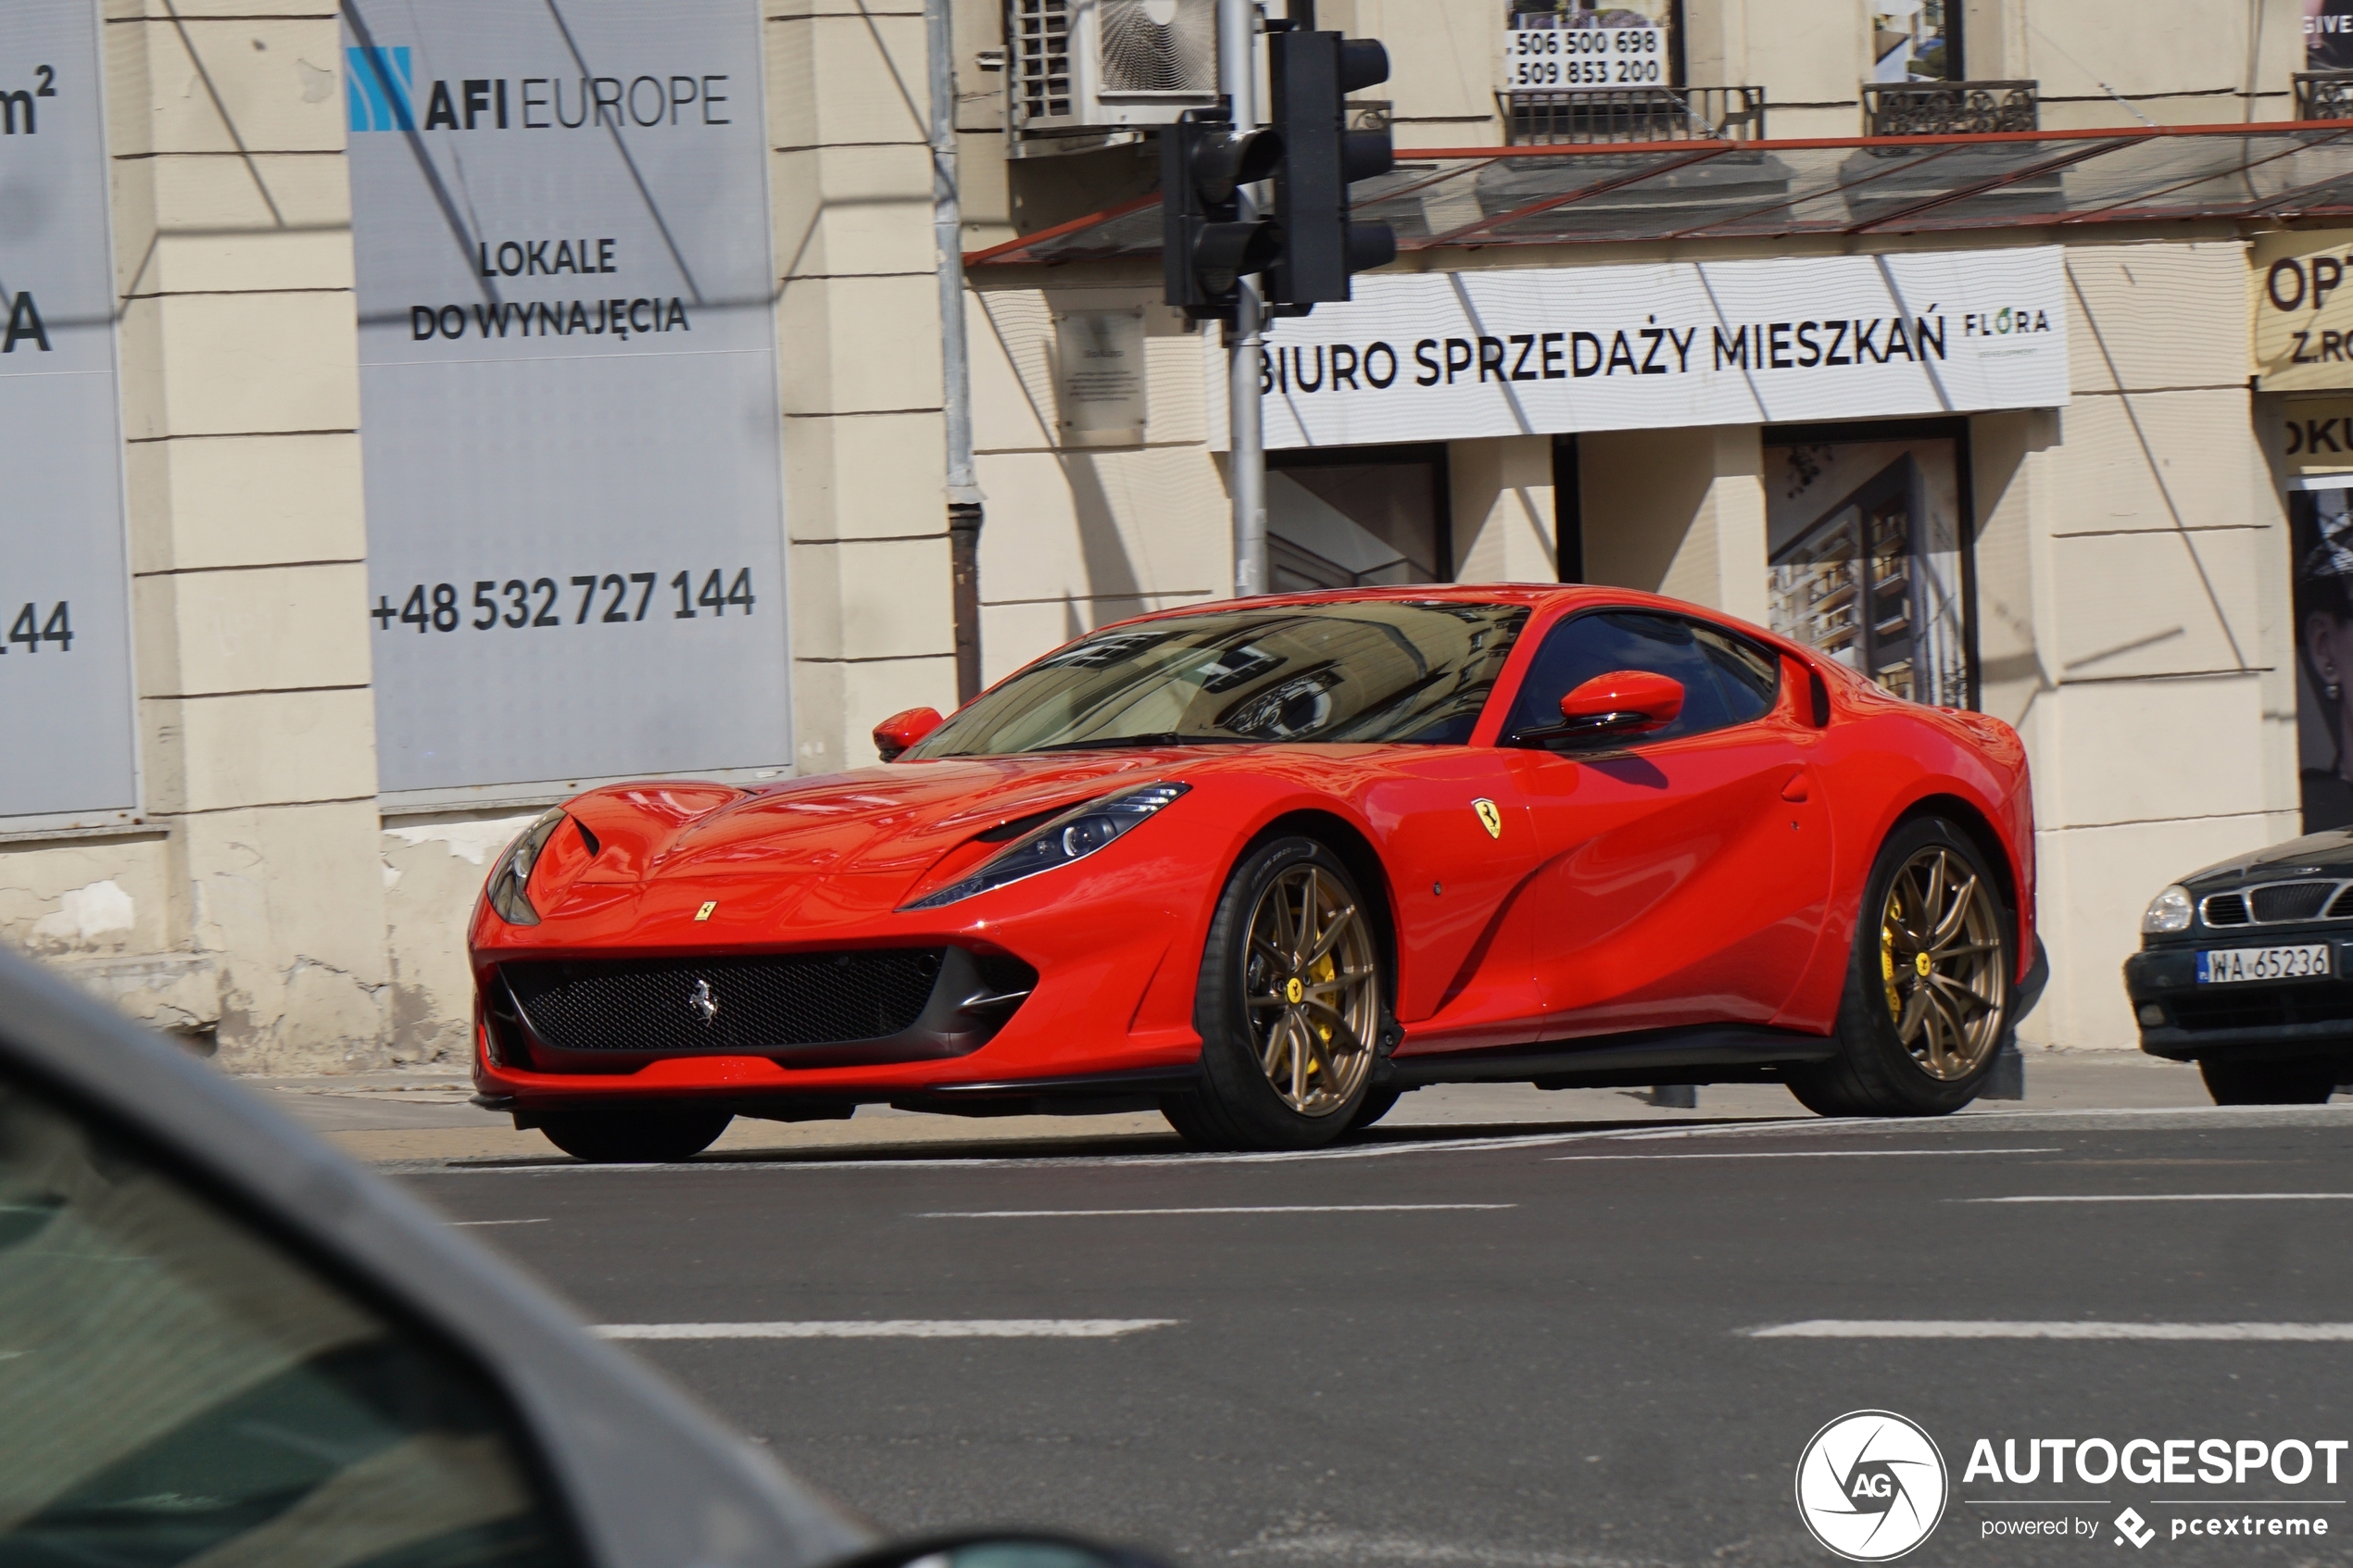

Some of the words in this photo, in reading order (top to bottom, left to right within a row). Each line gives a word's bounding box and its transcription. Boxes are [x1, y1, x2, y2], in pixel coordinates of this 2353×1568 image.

[1517, 32, 1559, 56] 506
[1567, 31, 1607, 55] 500
[1617, 31, 1656, 53] 698
[1517, 62, 1559, 84] 509
[1568, 61, 1608, 83] 853
[1617, 59, 1658, 82] 200
[424, 79, 508, 131] AFI
[522, 75, 732, 129] EUROPE
[480, 238, 616, 278] LOKALE
[410, 304, 466, 342] DO
[472, 296, 691, 342] WYNAJĘCIA
[1964, 307, 2051, 337] FLORA
[1414, 314, 1696, 387] SPRZEDAŻY
[1713, 303, 1946, 371] MIESZKAŃ
[371, 582, 459, 634] +48
[472, 578, 561, 632] 532
[570, 571, 658, 625] 727
[671, 567, 756, 620] 144
[2211, 952, 2245, 982] WA
[2254, 947, 2325, 978] 65236
